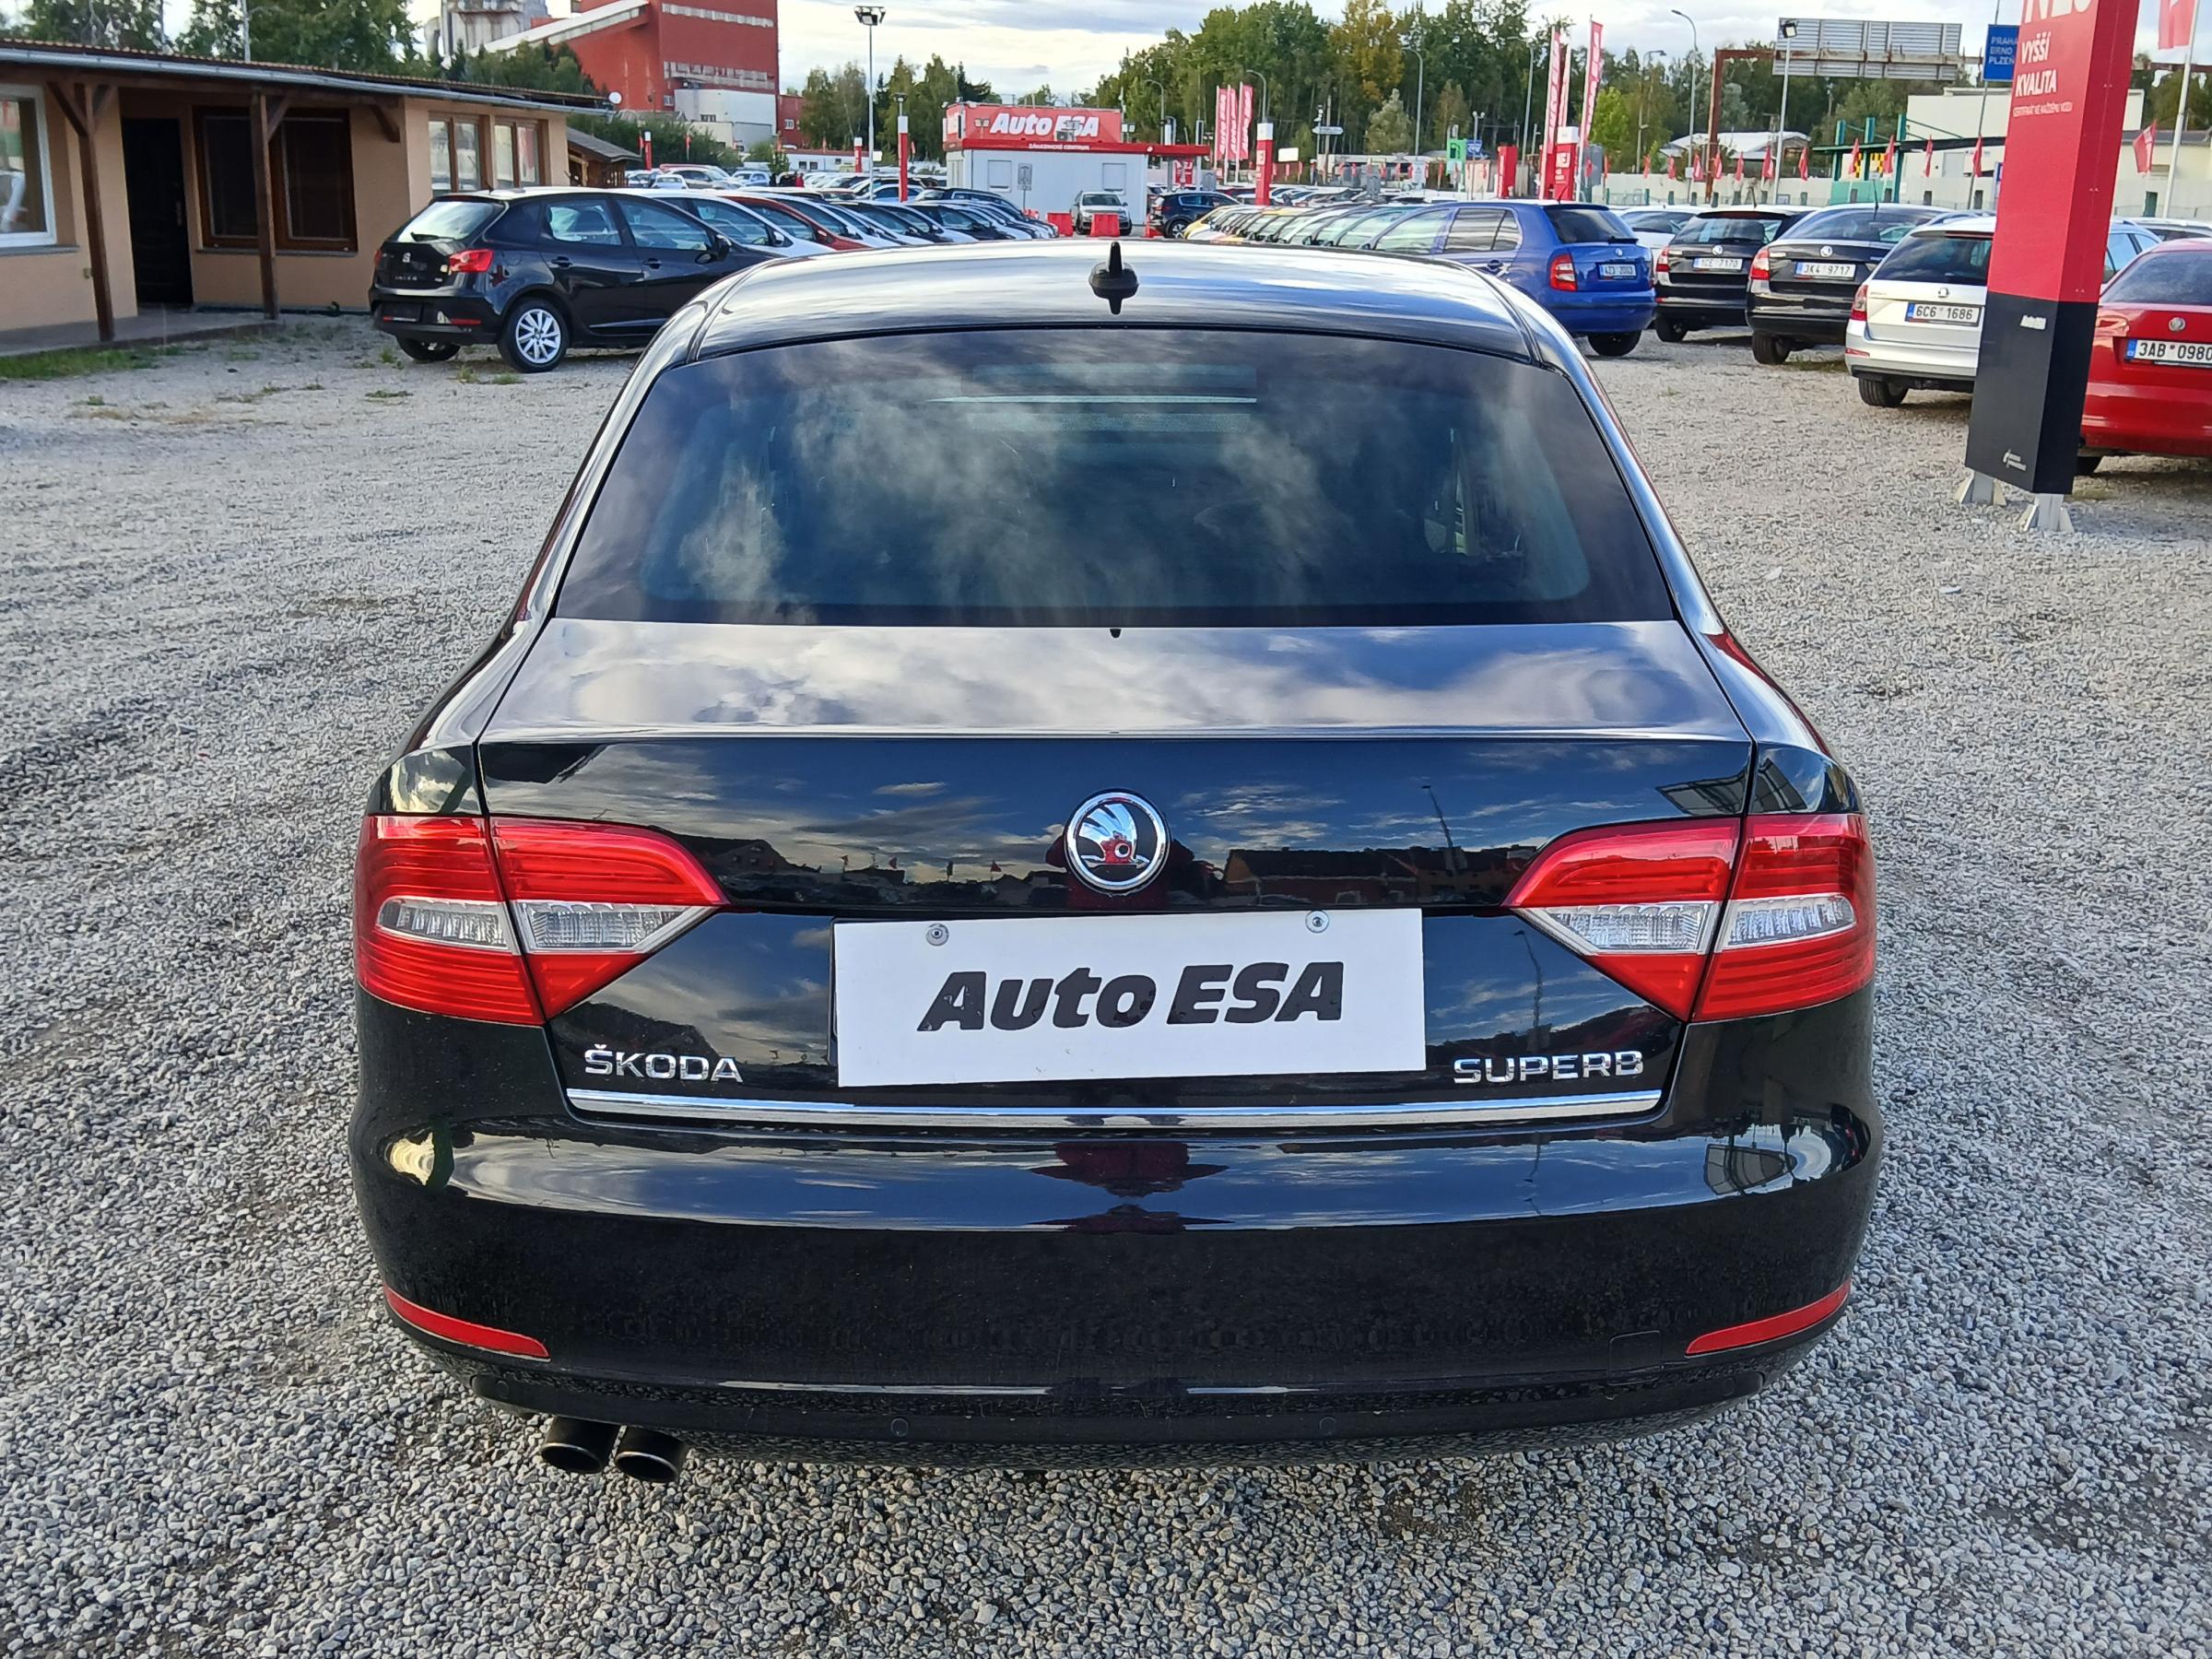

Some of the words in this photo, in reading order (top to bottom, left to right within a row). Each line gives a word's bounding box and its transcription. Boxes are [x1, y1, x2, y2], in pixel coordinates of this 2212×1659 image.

[1991, 46, 2013, 55] BRNO
[2021, 31, 2052, 65] VYŠŠÍ
[2015, 69, 2056, 97] KVALITA
[990, 112, 1053, 135] Auto
[1804, 264, 1820, 274] 3K4
[1828, 265, 1850, 276] 9717
[1915, 305, 1936, 318] 6C6
[1947, 307, 1973, 320] 1686
[2138, 342, 2166, 358] 3AB
[2177, 345, 2212, 361] 0980
[917, 968, 1157, 1031] Auto
[1166, 961, 1344, 1025] ESA
[584, 1043, 744, 1083] ŠKODA
[1453, 1050, 1643, 1084] SUPERB
